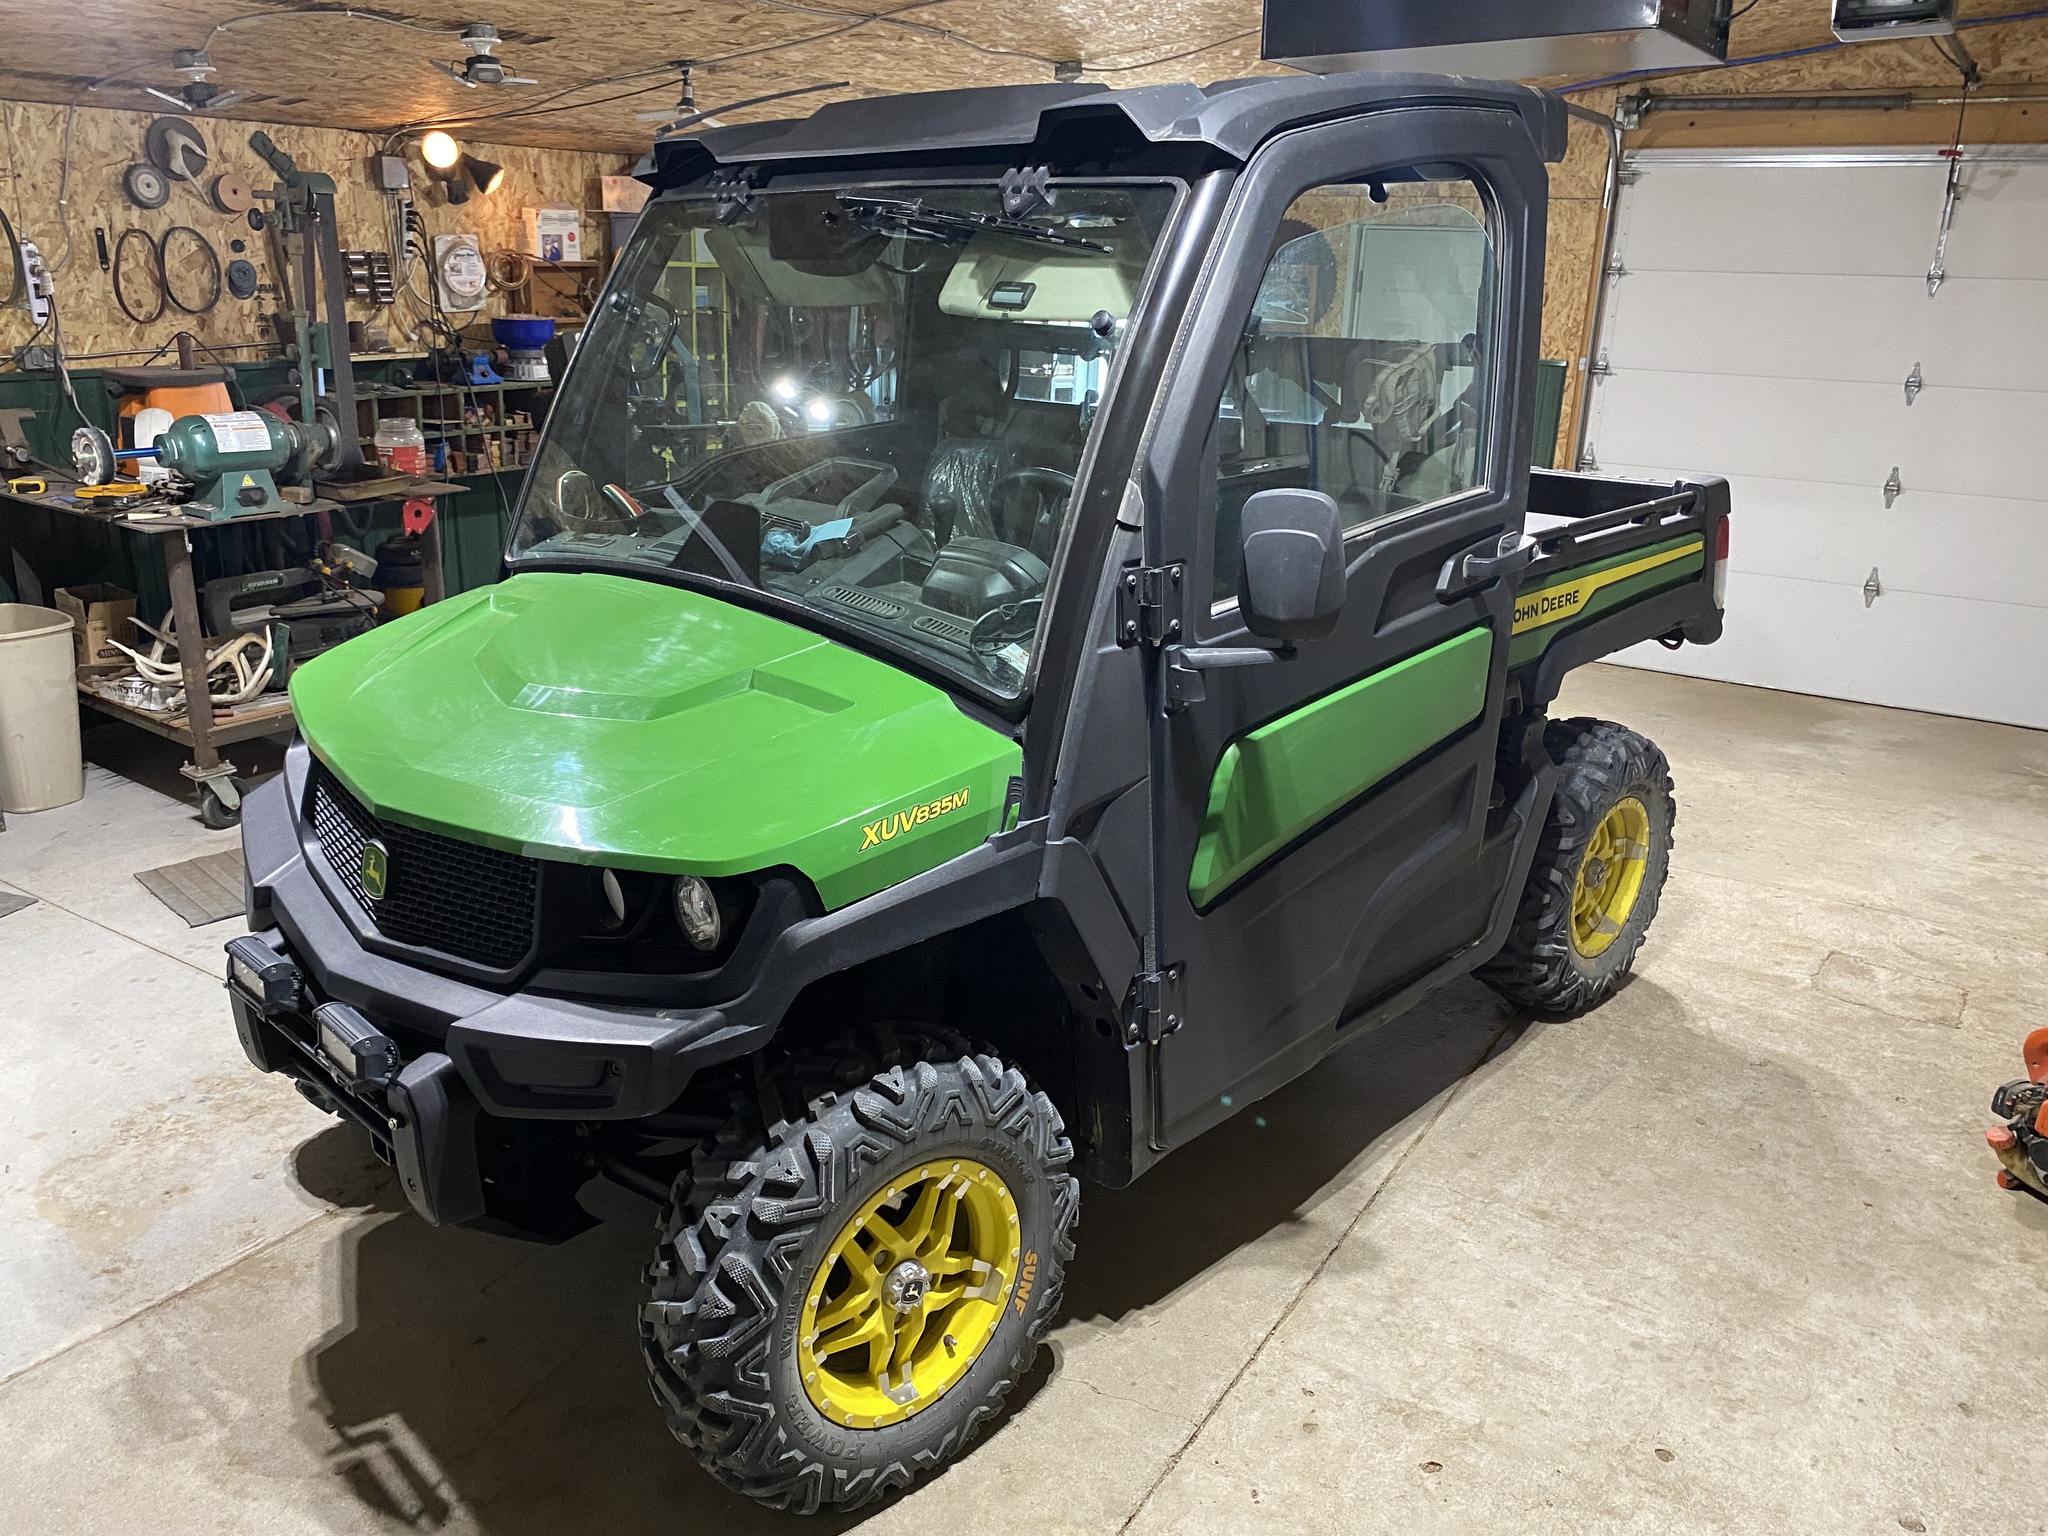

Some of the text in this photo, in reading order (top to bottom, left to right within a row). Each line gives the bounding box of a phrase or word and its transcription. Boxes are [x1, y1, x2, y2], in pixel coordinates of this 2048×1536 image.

[1513, 590, 1579, 624] OHN DEERE
[99, 649, 122, 658] MINW
[107, 686, 146, 695] ONSTER
[858, 786, 970, 852] XUV835M
[1014, 1248, 1038, 1320] SUNF
[785, 1393, 866, 1460] POWER
